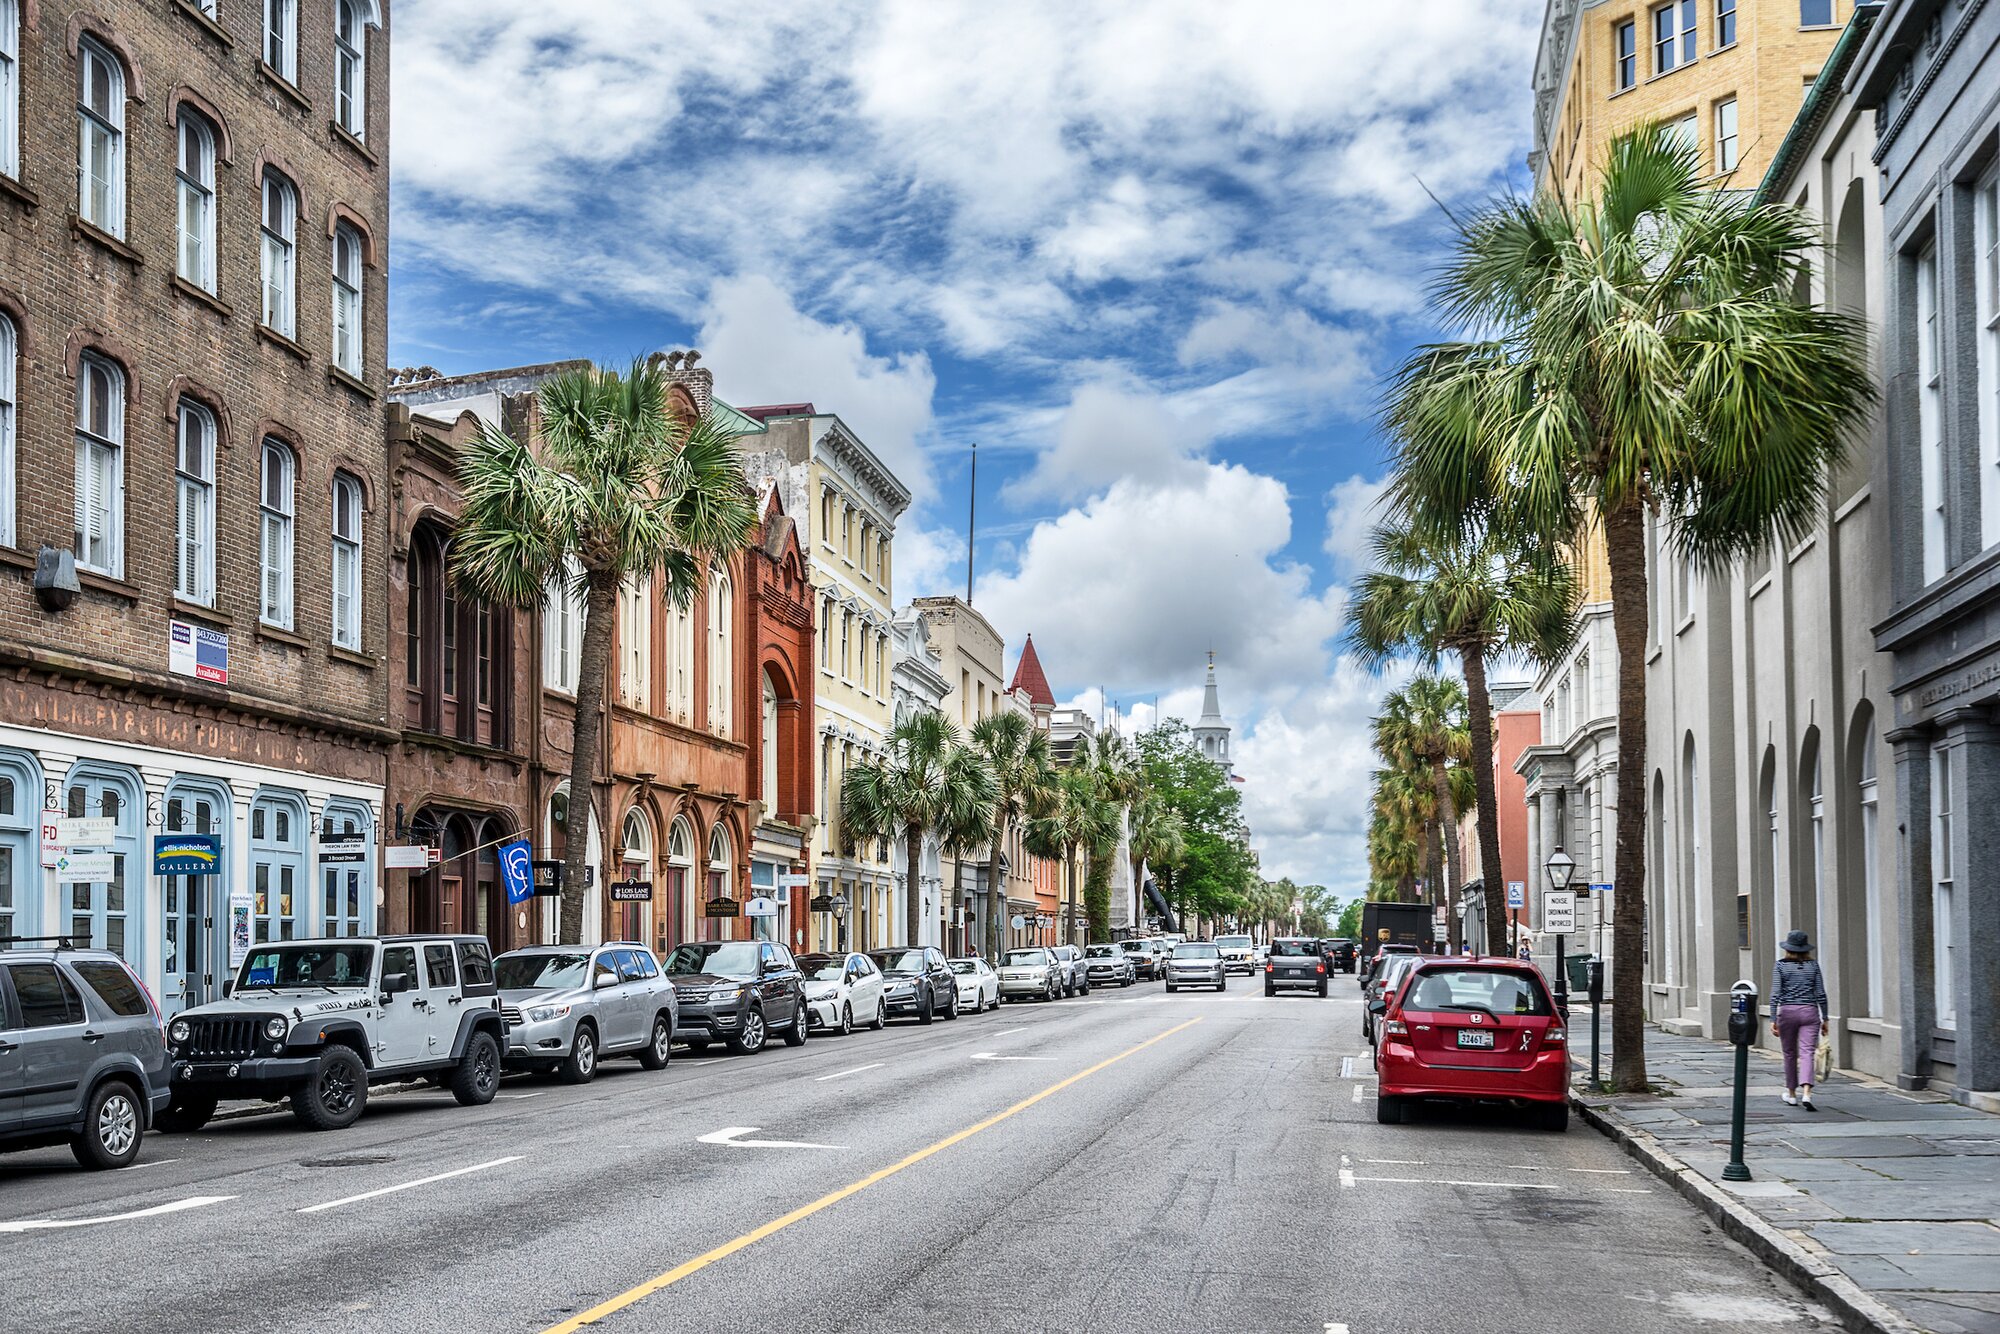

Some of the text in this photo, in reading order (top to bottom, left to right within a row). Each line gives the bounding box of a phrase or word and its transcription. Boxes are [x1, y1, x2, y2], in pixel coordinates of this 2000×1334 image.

[196, 666, 221, 680] Available
[163, 843, 211, 852] ellis-nicholson
[159, 862, 214, 871] GALLERY
[1551, 897, 1568, 905] NOISE
[1547, 908, 1573, 916] ORDINANCE
[1548, 919, 1572, 927] ENFORCED
